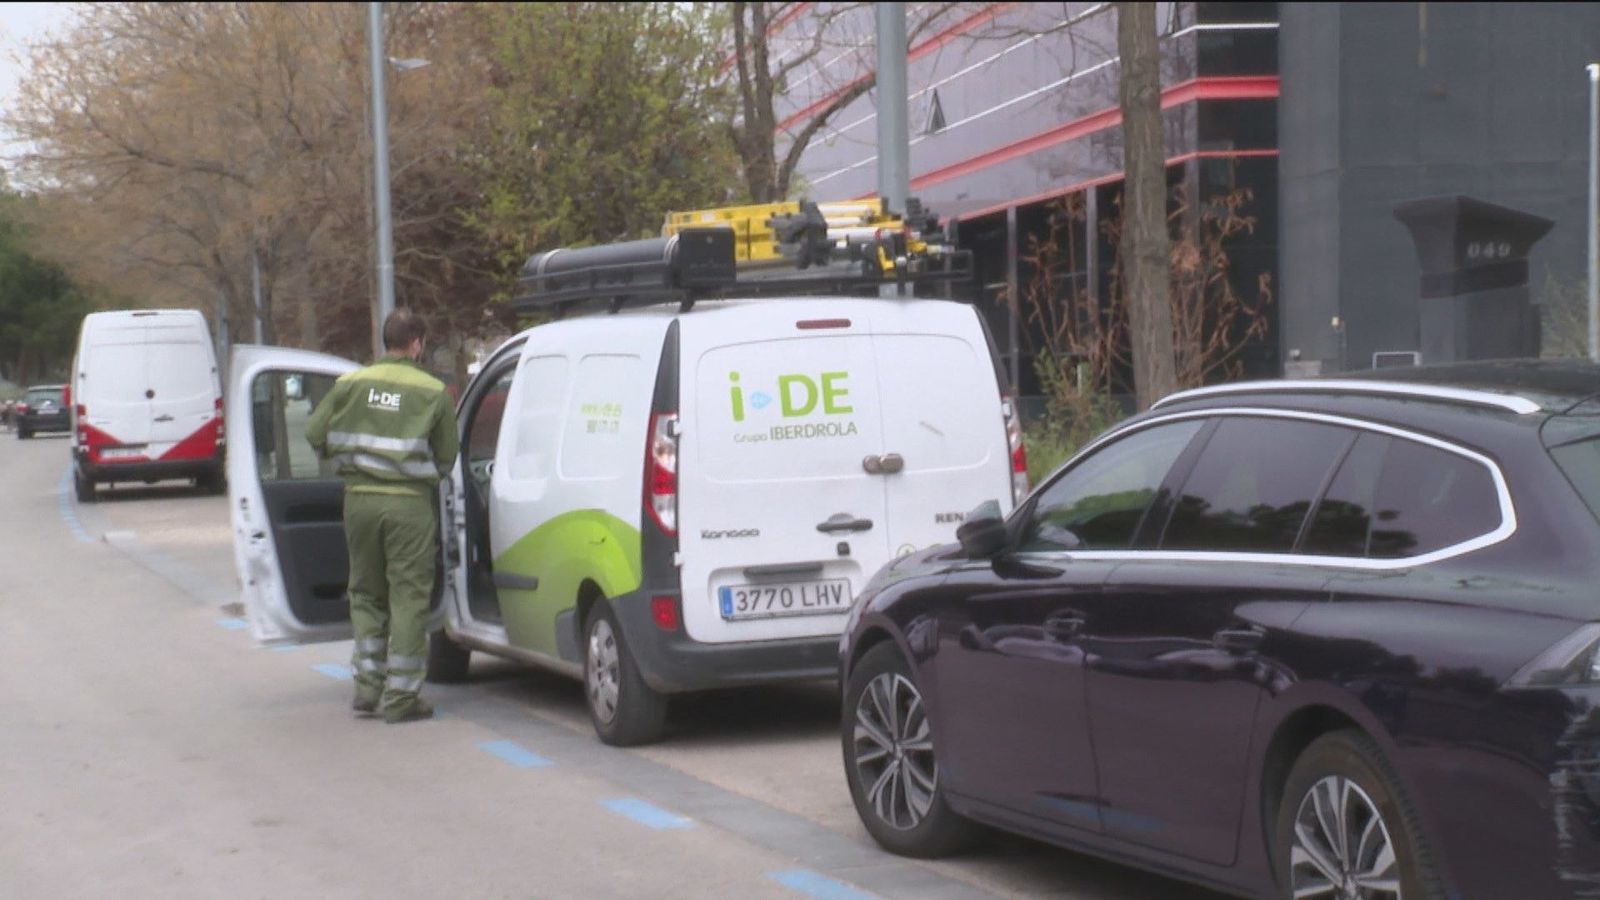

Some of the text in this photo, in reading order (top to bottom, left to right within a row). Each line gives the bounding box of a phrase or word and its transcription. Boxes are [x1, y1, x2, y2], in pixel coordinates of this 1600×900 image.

[770, 421, 858, 441] IBERDROLA
[736, 584, 842, 611] 3770 LHV
